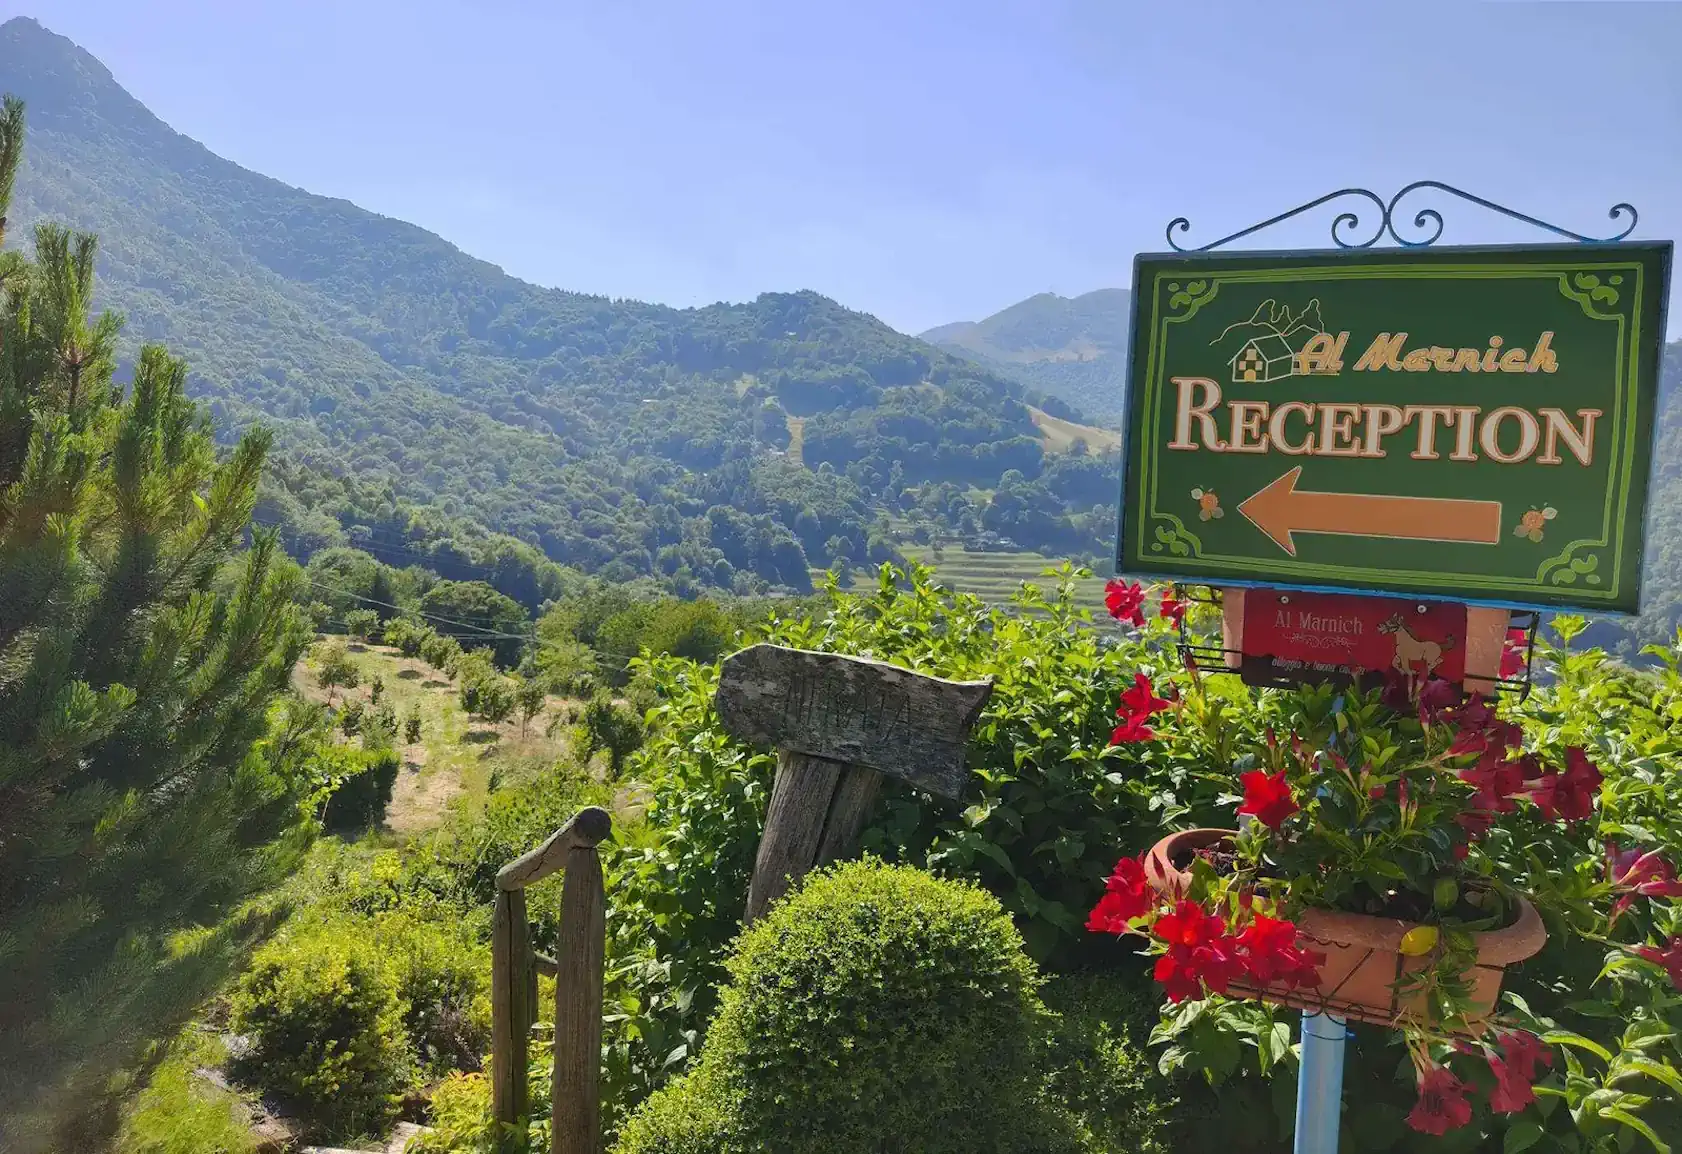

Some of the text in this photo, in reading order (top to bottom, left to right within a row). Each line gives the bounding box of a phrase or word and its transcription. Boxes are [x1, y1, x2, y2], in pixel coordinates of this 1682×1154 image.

[1294, 331, 1559, 375] Al Marnich
[1167, 376, 1604, 466] RECEPTION
[1274, 610, 1362, 634] Al Marnich
